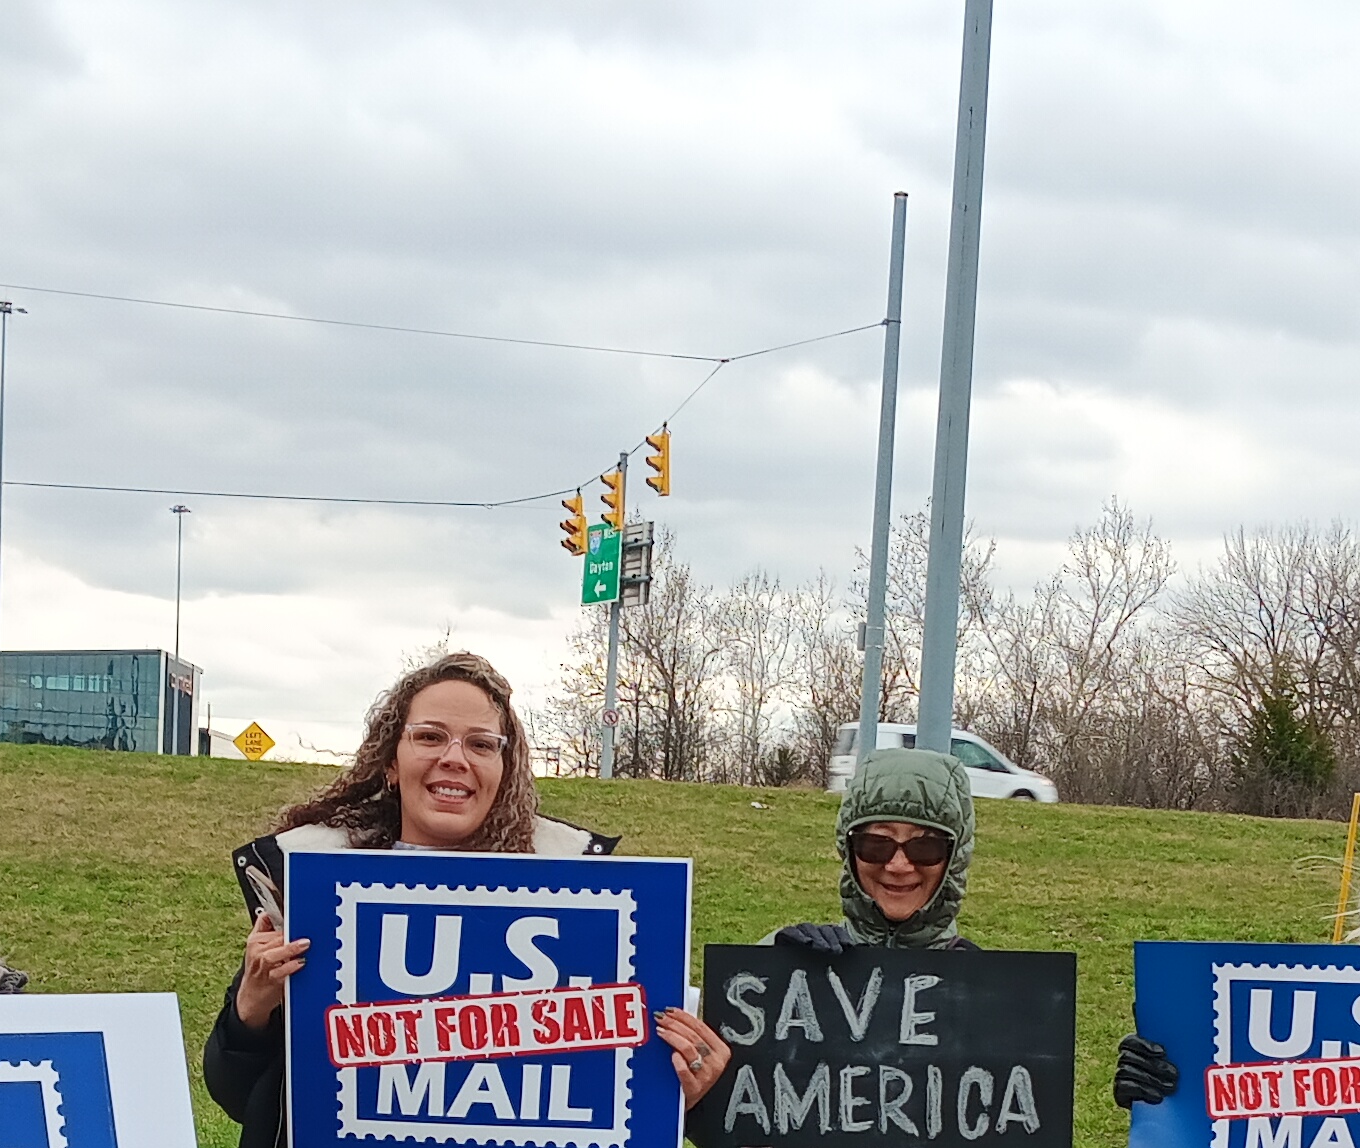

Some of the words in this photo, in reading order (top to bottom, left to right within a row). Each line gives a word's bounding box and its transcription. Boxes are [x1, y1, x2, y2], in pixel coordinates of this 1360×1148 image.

[589, 561, 613, 575] Dayton
[378, 913, 593, 996] U.S.
[334, 1008, 424, 1060] NOT
[434, 1003, 521, 1053] FOR
[531, 992, 639, 1046] SALE
[719, 965, 943, 1047] SAVE
[376, 1061, 593, 1123] MAIL
[723, 1061, 1041, 1141] AMERICA
[1211, 1070, 1284, 1112] NOT
